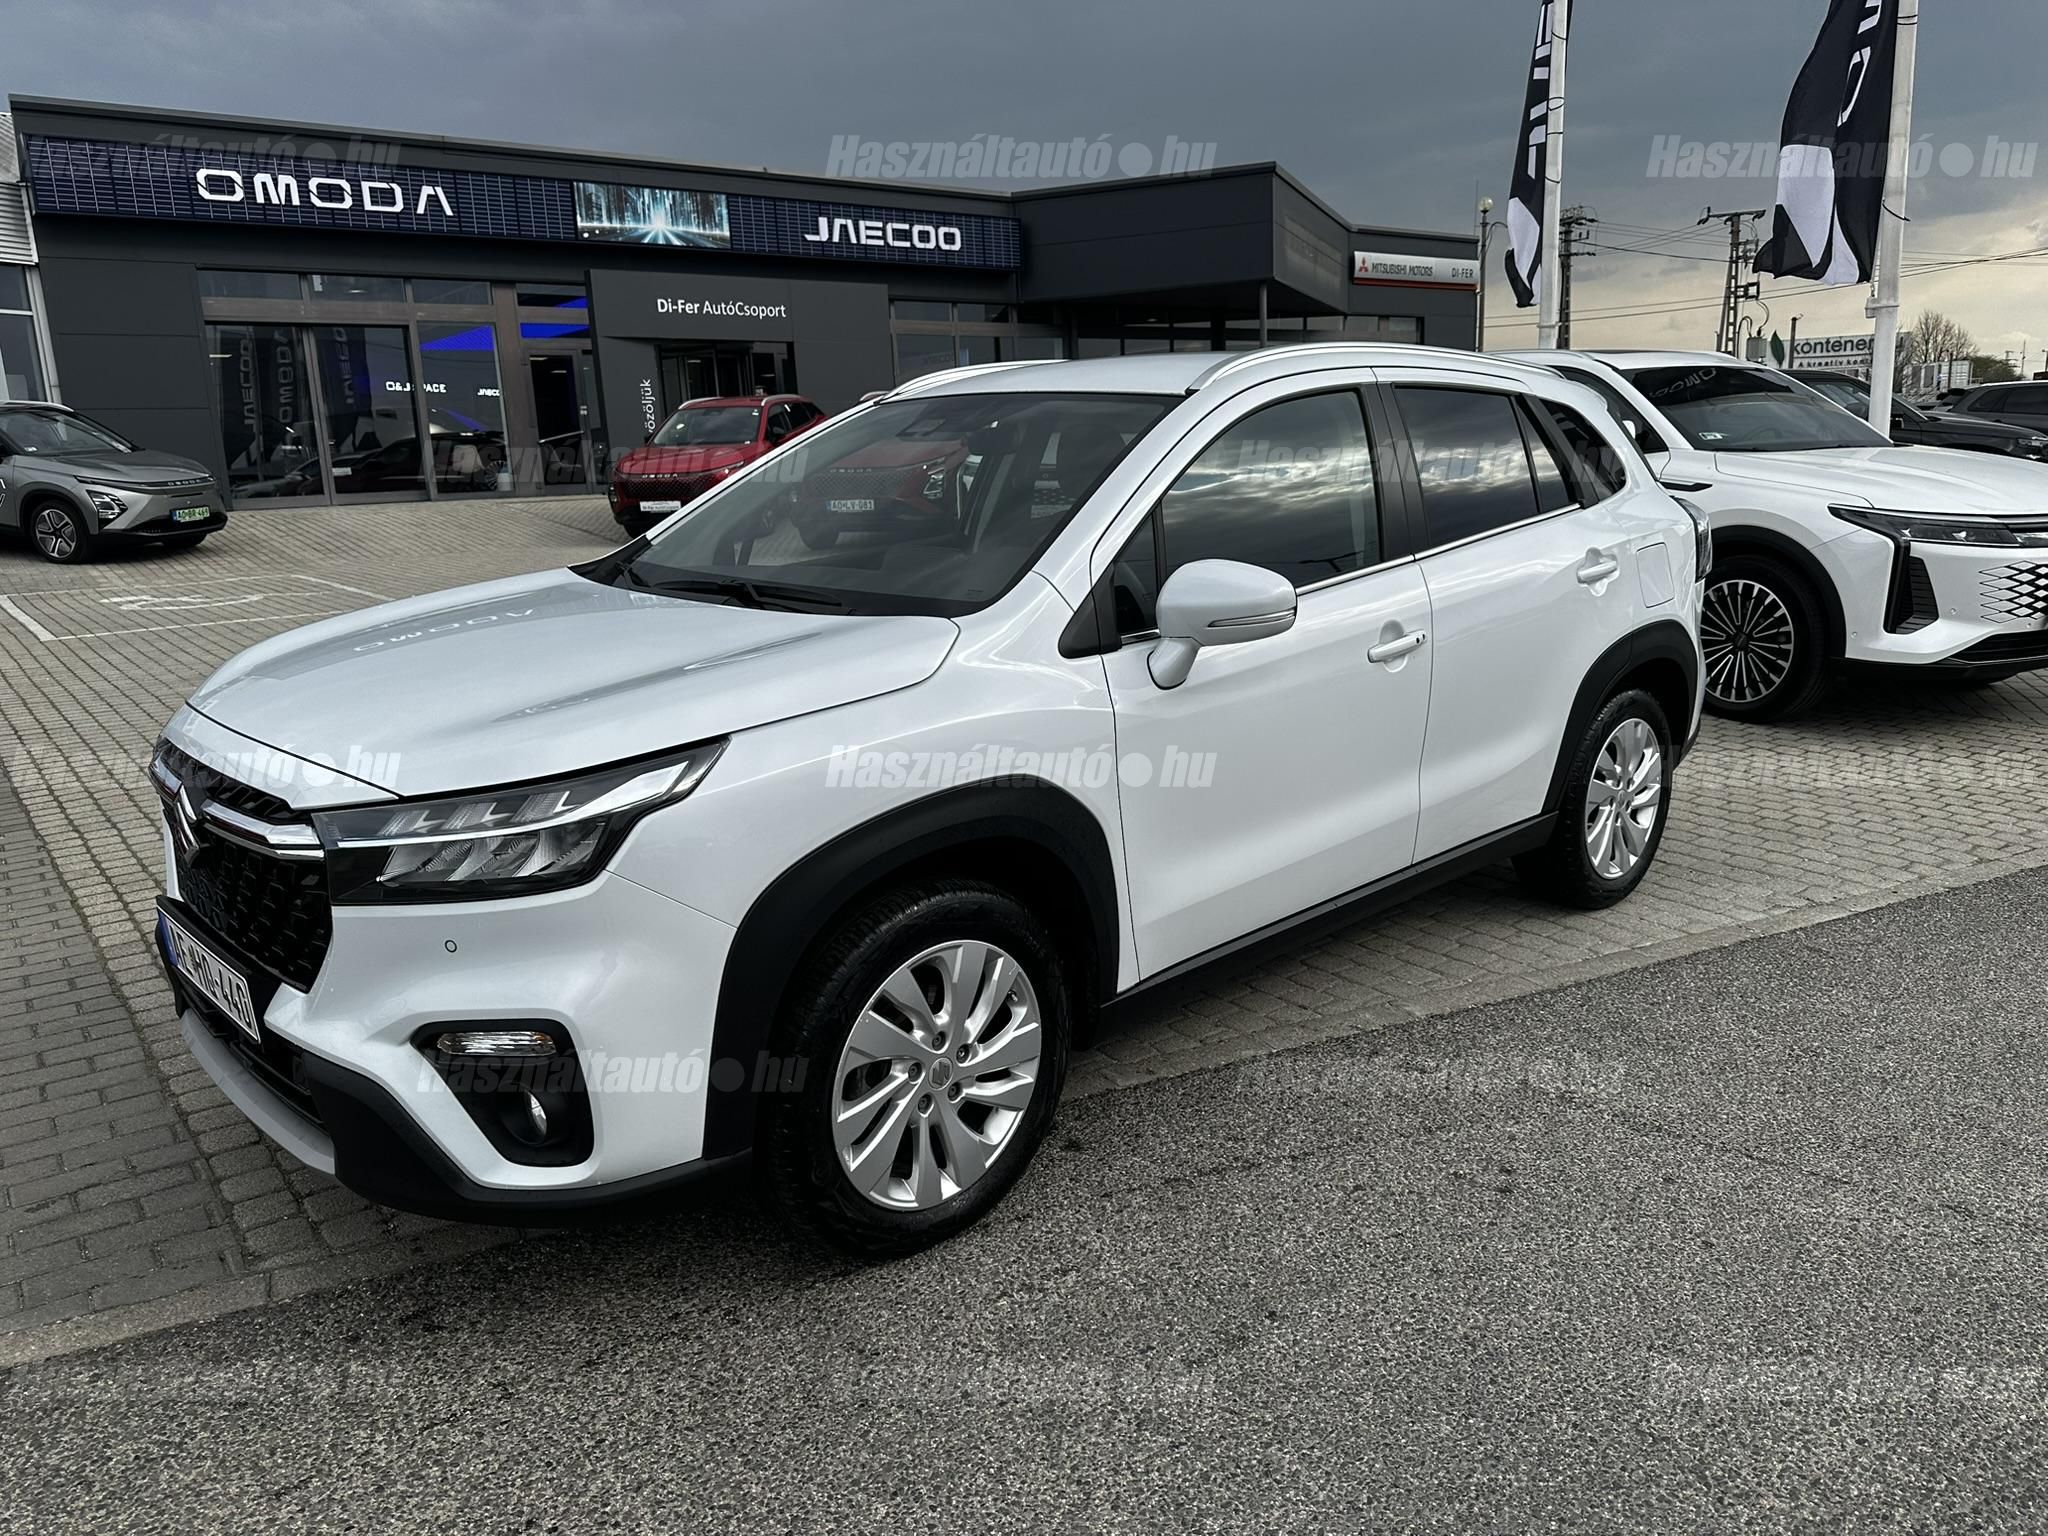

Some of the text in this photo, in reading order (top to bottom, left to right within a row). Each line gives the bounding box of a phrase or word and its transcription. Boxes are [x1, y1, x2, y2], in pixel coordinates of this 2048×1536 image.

[196, 168, 454, 216] OMODA
[804, 217, 961, 251] JAECOO
[1372, 262, 1433, 276] MITSUBISHI MOTORS
[1451, 267, 1474, 279] DI-FER
[657, 298, 786, 320] Di-Fer AutóCsoport
[640, 379, 656, 433] özöljük
